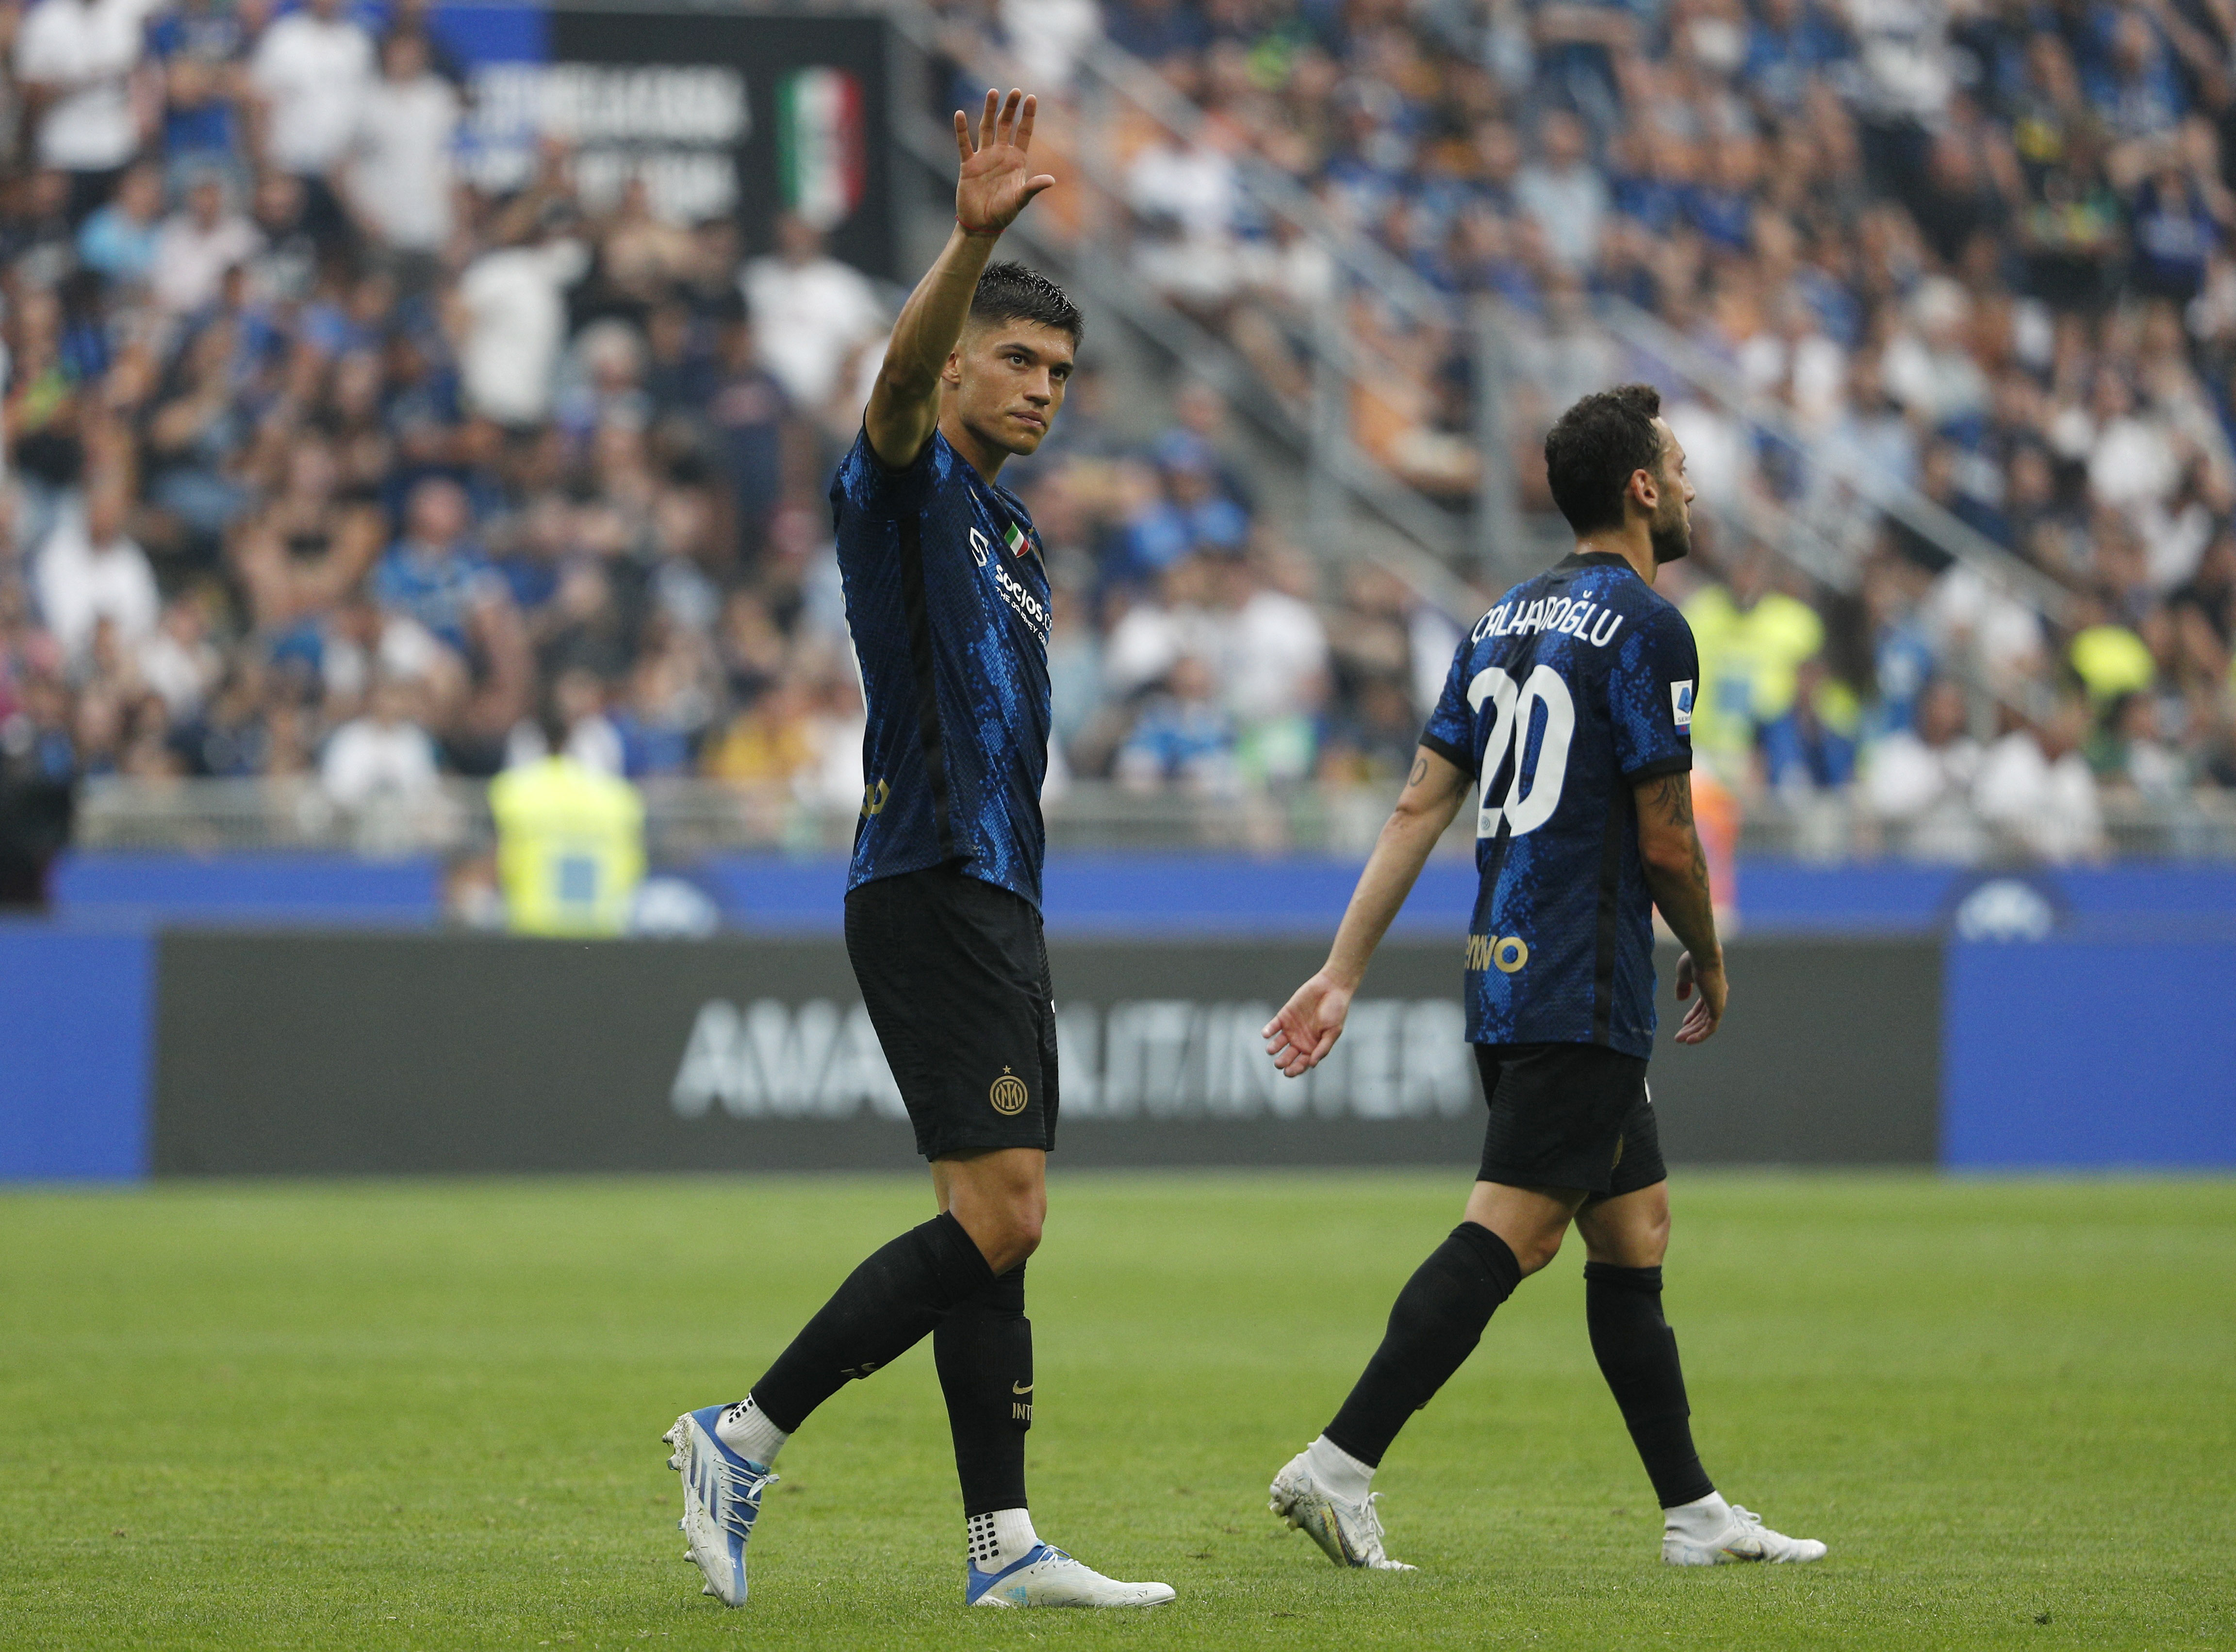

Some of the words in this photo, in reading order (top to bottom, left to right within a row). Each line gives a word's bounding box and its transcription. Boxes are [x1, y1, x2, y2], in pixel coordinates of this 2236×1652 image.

[995, 586, 1011, 603] THE
[995, 564, 1052, 631] SOCIOS.C
[1467, 664, 1575, 838] 20
[1012, 1402, 1033, 1421] INT
